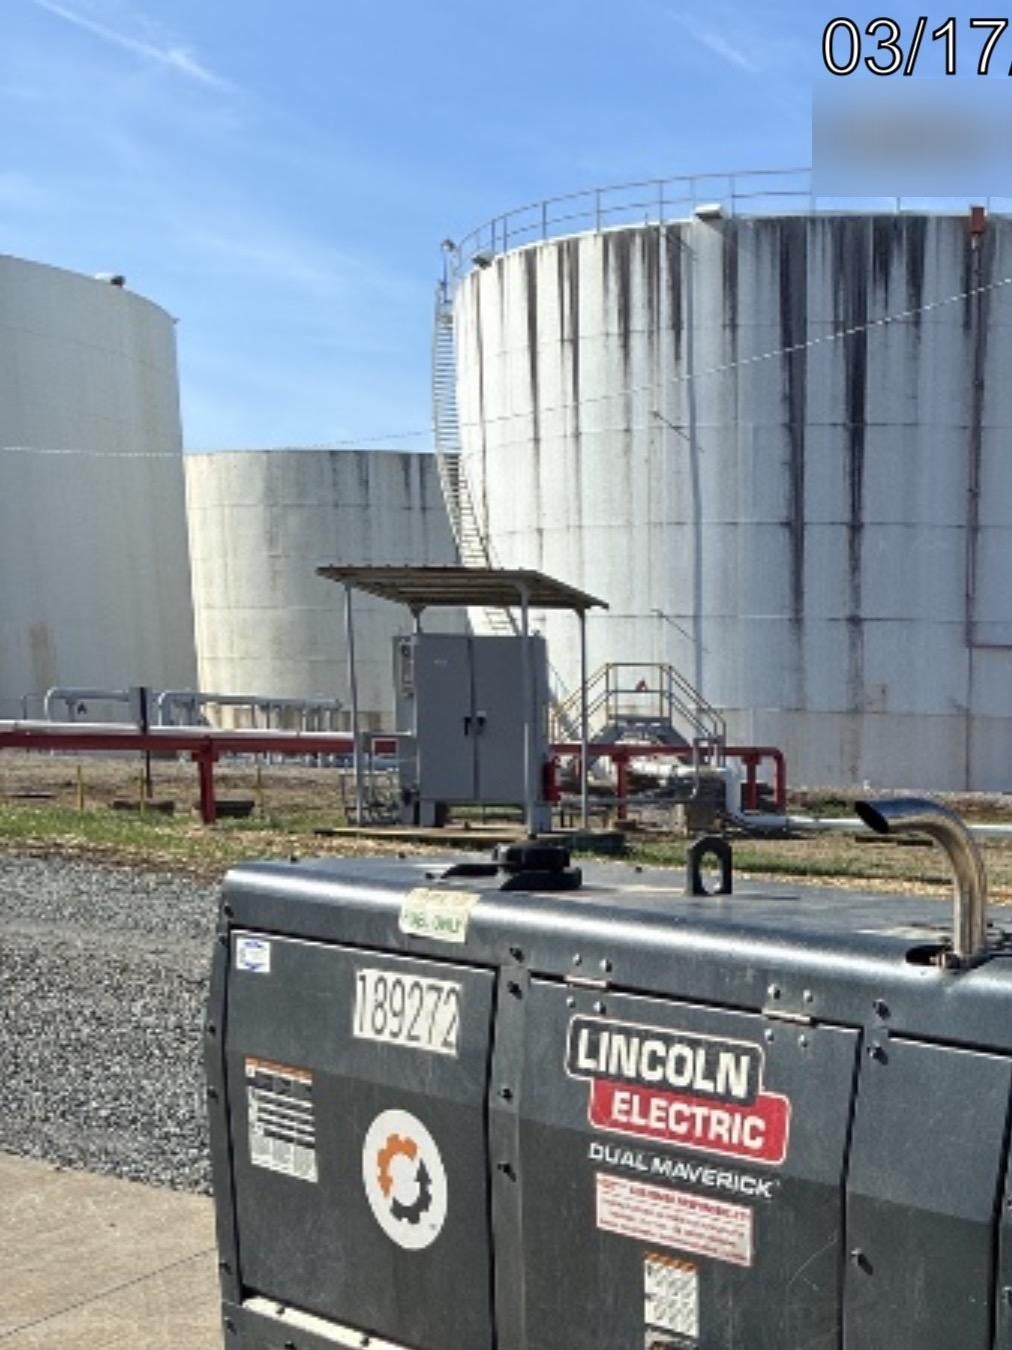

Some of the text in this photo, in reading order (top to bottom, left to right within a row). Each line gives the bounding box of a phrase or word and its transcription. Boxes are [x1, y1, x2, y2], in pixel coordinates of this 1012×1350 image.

[358, 974, 460, 1050] 189272
[577, 1028, 751, 1099] LINCOLN
[610, 1090, 766, 1149] ELECTRIC
[588, 1142, 773, 1198] DUAL MAVERICK
